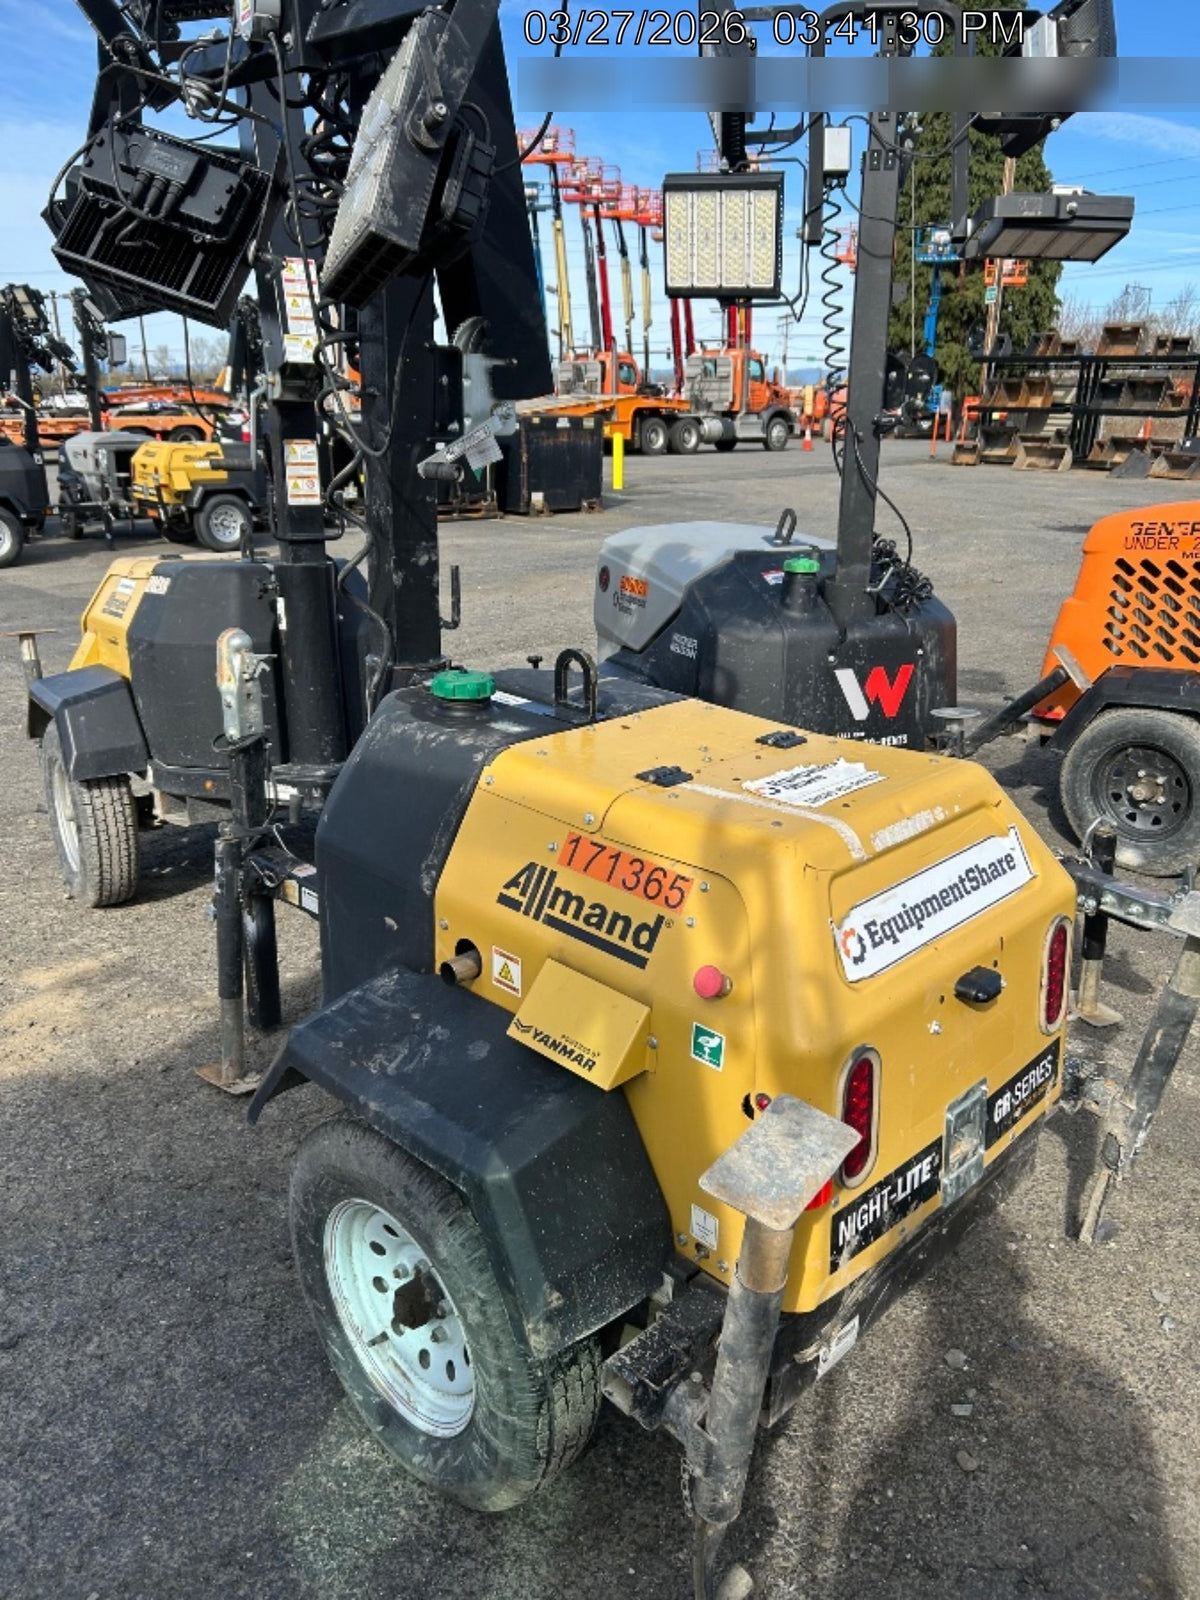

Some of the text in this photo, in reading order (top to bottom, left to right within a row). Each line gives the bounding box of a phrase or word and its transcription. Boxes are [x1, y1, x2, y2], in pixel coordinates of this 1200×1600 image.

[1125, 536, 1180, 550] UNDER
[501, 861, 667, 954] Allmand
[566, 835, 692, 910] 171365
[863, 851, 1017, 951] EquipmentShare
[531, 1027, 597, 1073] YANMAR
[1013, 1055, 1053, 1104] SERIES
[838, 1153, 934, 1247] NIGHT-LITE
